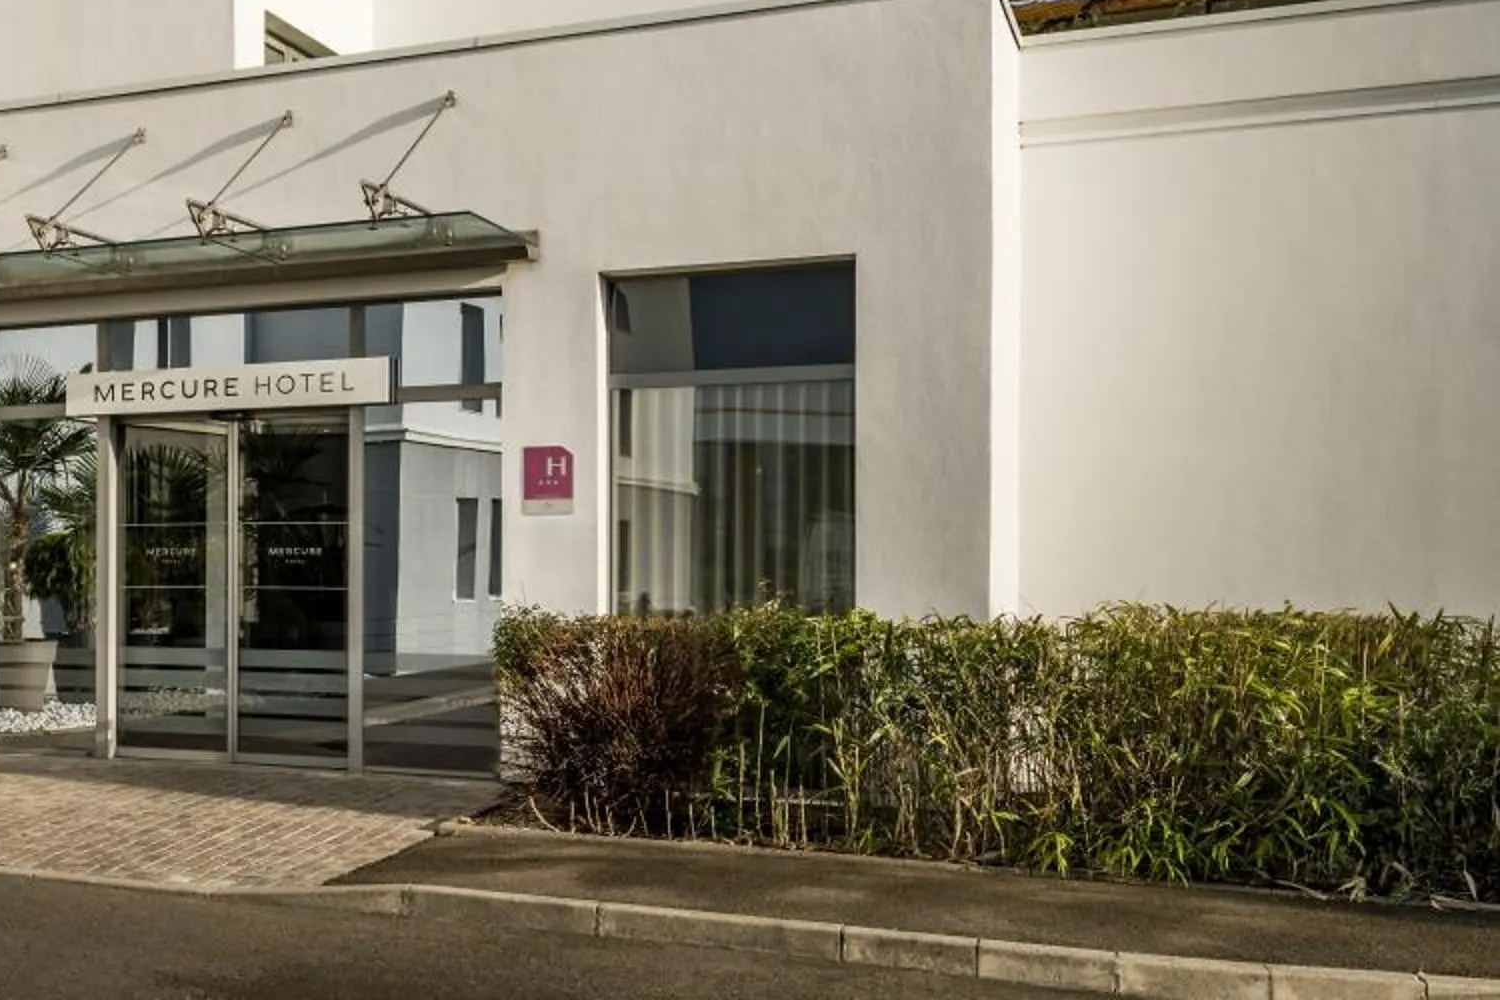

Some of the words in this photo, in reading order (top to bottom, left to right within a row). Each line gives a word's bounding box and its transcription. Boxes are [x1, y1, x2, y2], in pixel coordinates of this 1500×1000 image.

[93, 376, 239, 402] MERCURE
[254, 370, 355, 396] HOTEL
[546, 456, 567, 477] H
[267, 546, 323, 557] MERCURE
